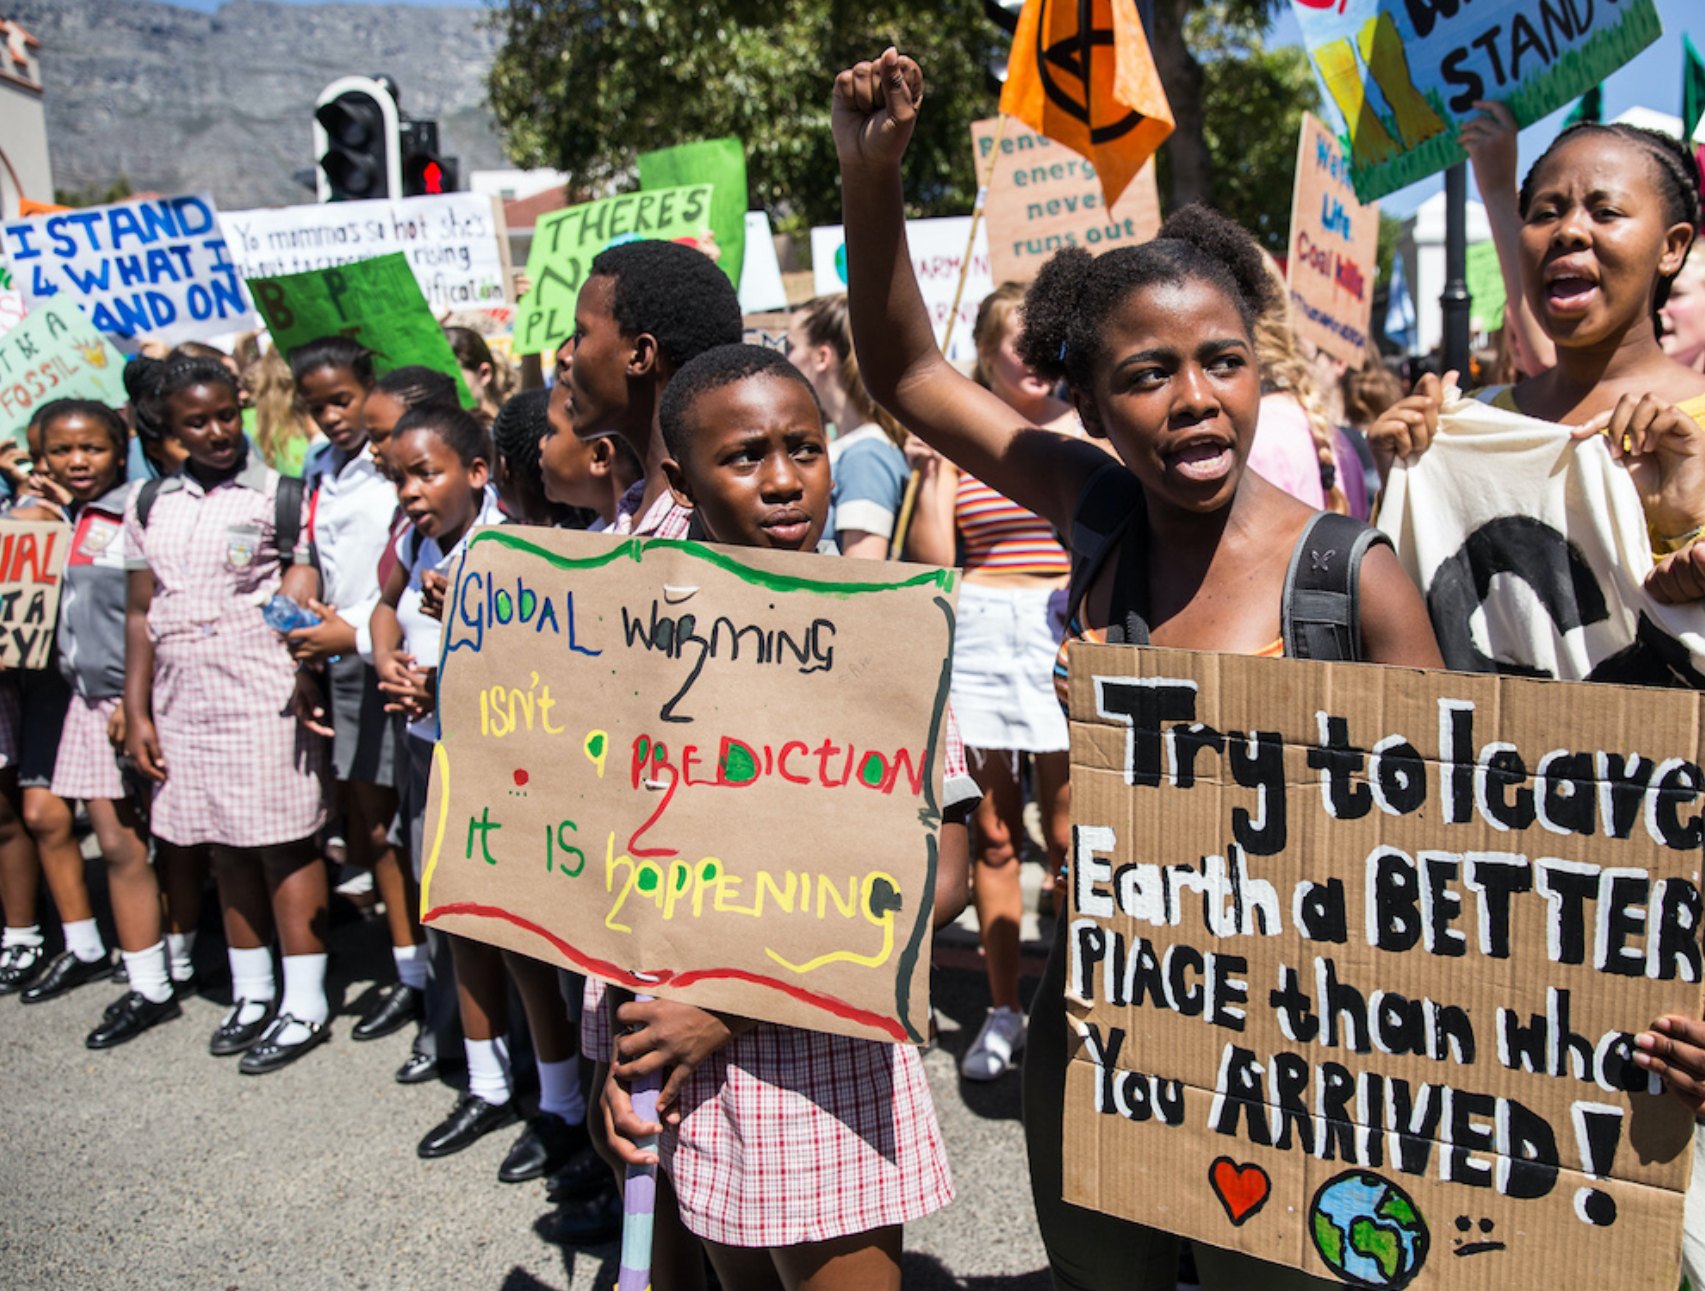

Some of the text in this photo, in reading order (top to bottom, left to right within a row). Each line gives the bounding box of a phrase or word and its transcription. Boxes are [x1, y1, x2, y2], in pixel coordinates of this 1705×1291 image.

[1013, 160, 1096, 187] energ
[6, 195, 214, 260] I STAND
[390, 207, 428, 242] hot
[545, 188, 708, 251] THERE'S
[1013, 218, 1135, 257] runs out
[33, 265, 58, 297] 4
[62, 245, 193, 294] WHAT
[203, 239, 234, 274] I
[536, 257, 582, 306] N
[45, 311, 68, 340] A
[78, 271, 246, 338] AND ON
[526, 310, 565, 346] PL
[0, 354, 79, 418] FOSSIL
[24, 589, 45, 625] A
[1092, 675, 1705, 856] Try to leave
[1072, 824, 1703, 984] Earth a BETTER
[1270, 956, 1476, 1065] than
